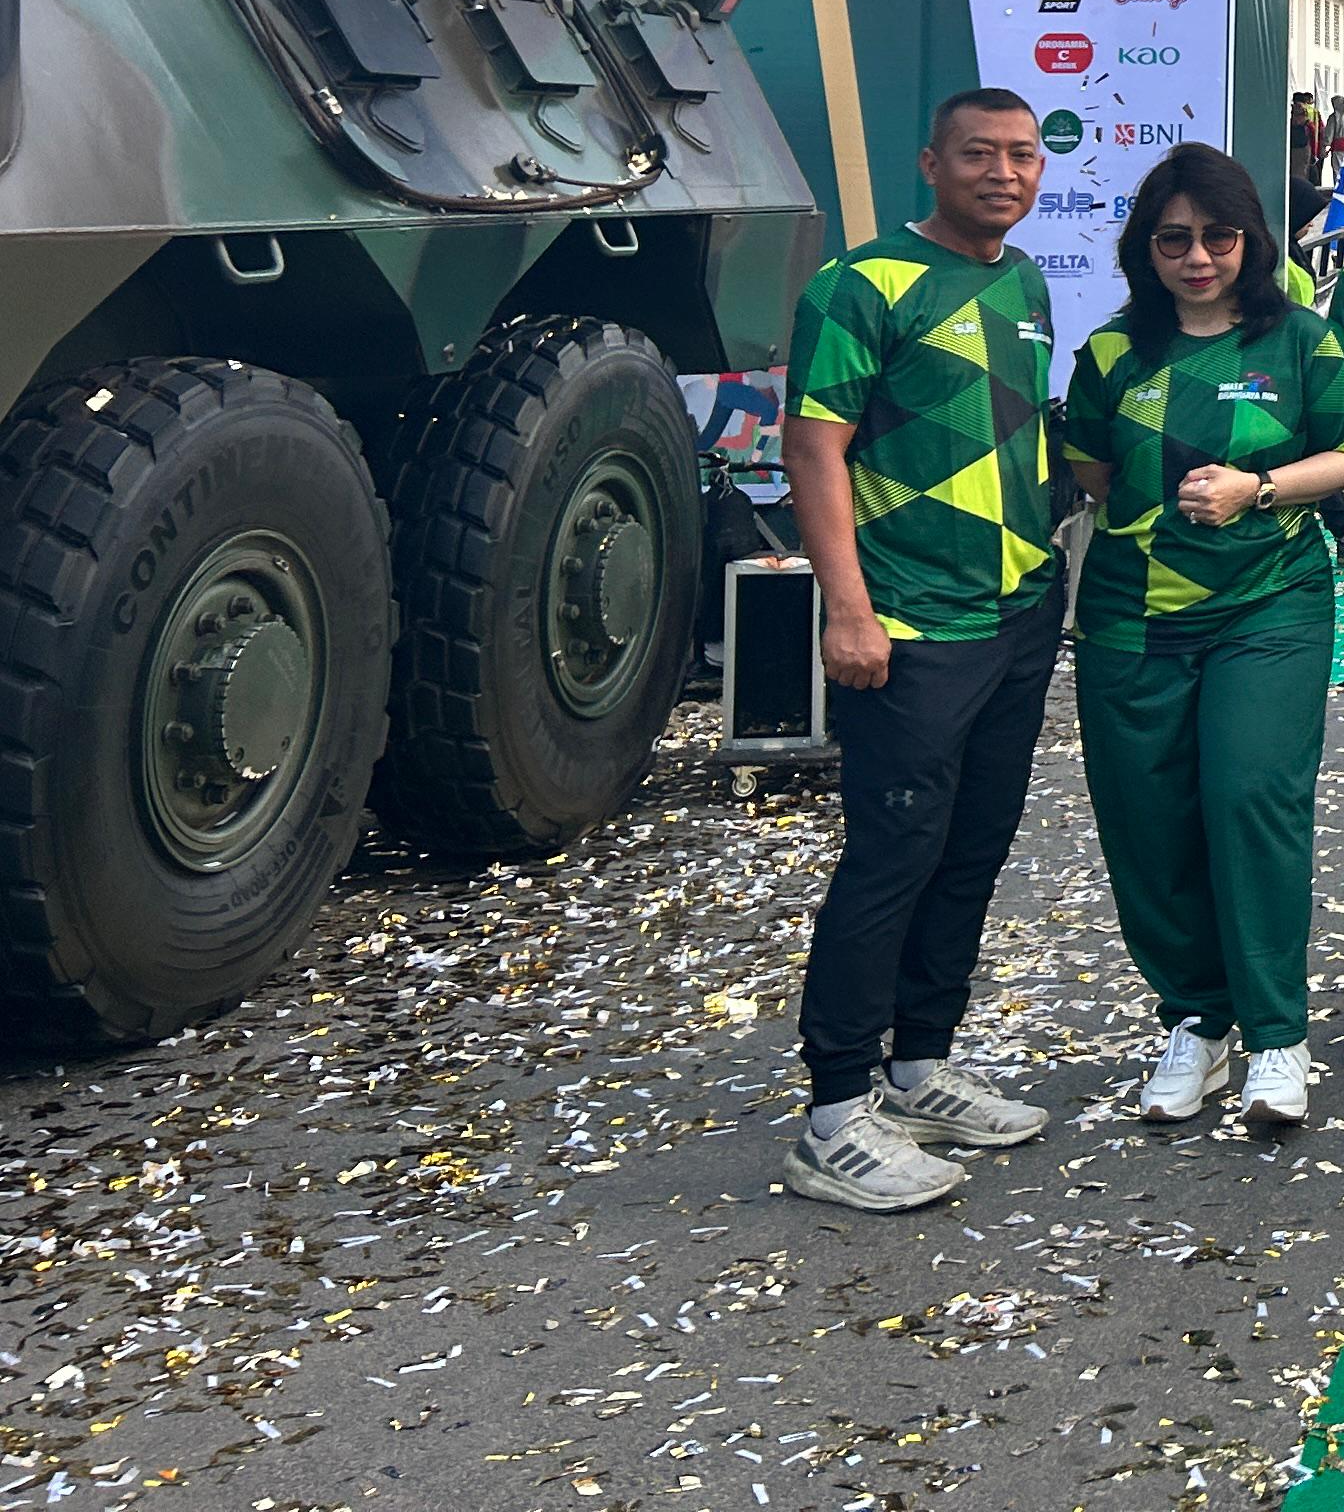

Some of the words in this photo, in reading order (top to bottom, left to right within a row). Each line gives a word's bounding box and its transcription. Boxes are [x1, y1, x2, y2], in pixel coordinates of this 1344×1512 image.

[1043, 1, 1077, 10] SPORT
[1058, 50, 1070, 61] C
[1139, 124, 1183, 145] BNI
[1034, 255, 1090, 269] DELTA
